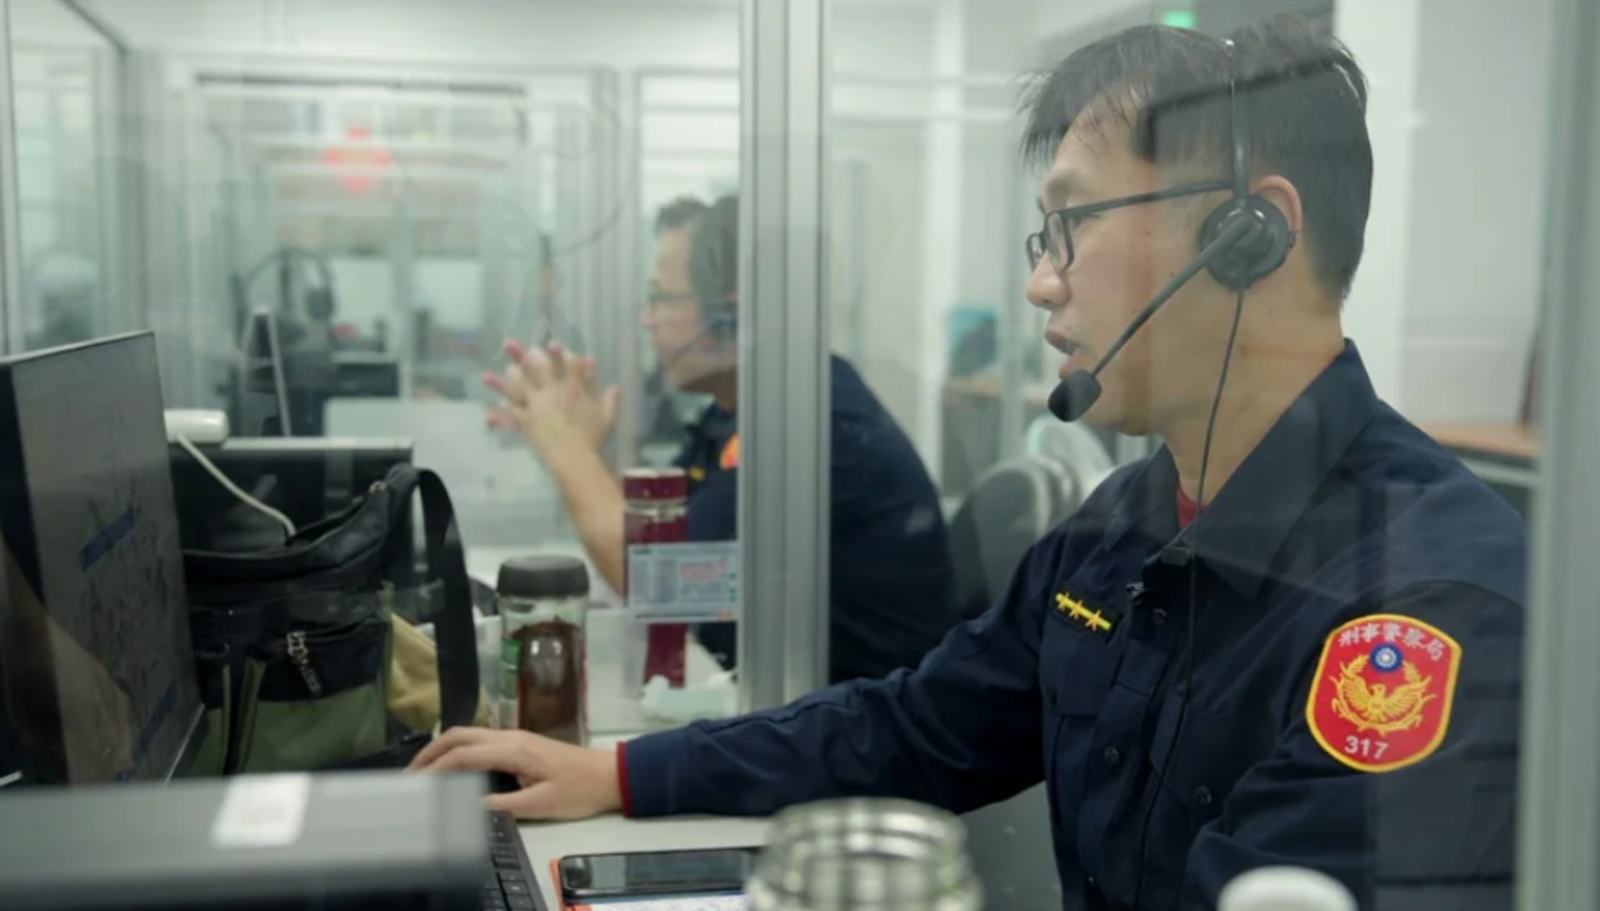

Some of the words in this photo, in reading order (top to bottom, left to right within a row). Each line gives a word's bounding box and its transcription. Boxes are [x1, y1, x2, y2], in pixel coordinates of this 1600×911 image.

[1338, 621, 1445, 662] 刑事警察局
[1344, 735, 1389, 759] 317
